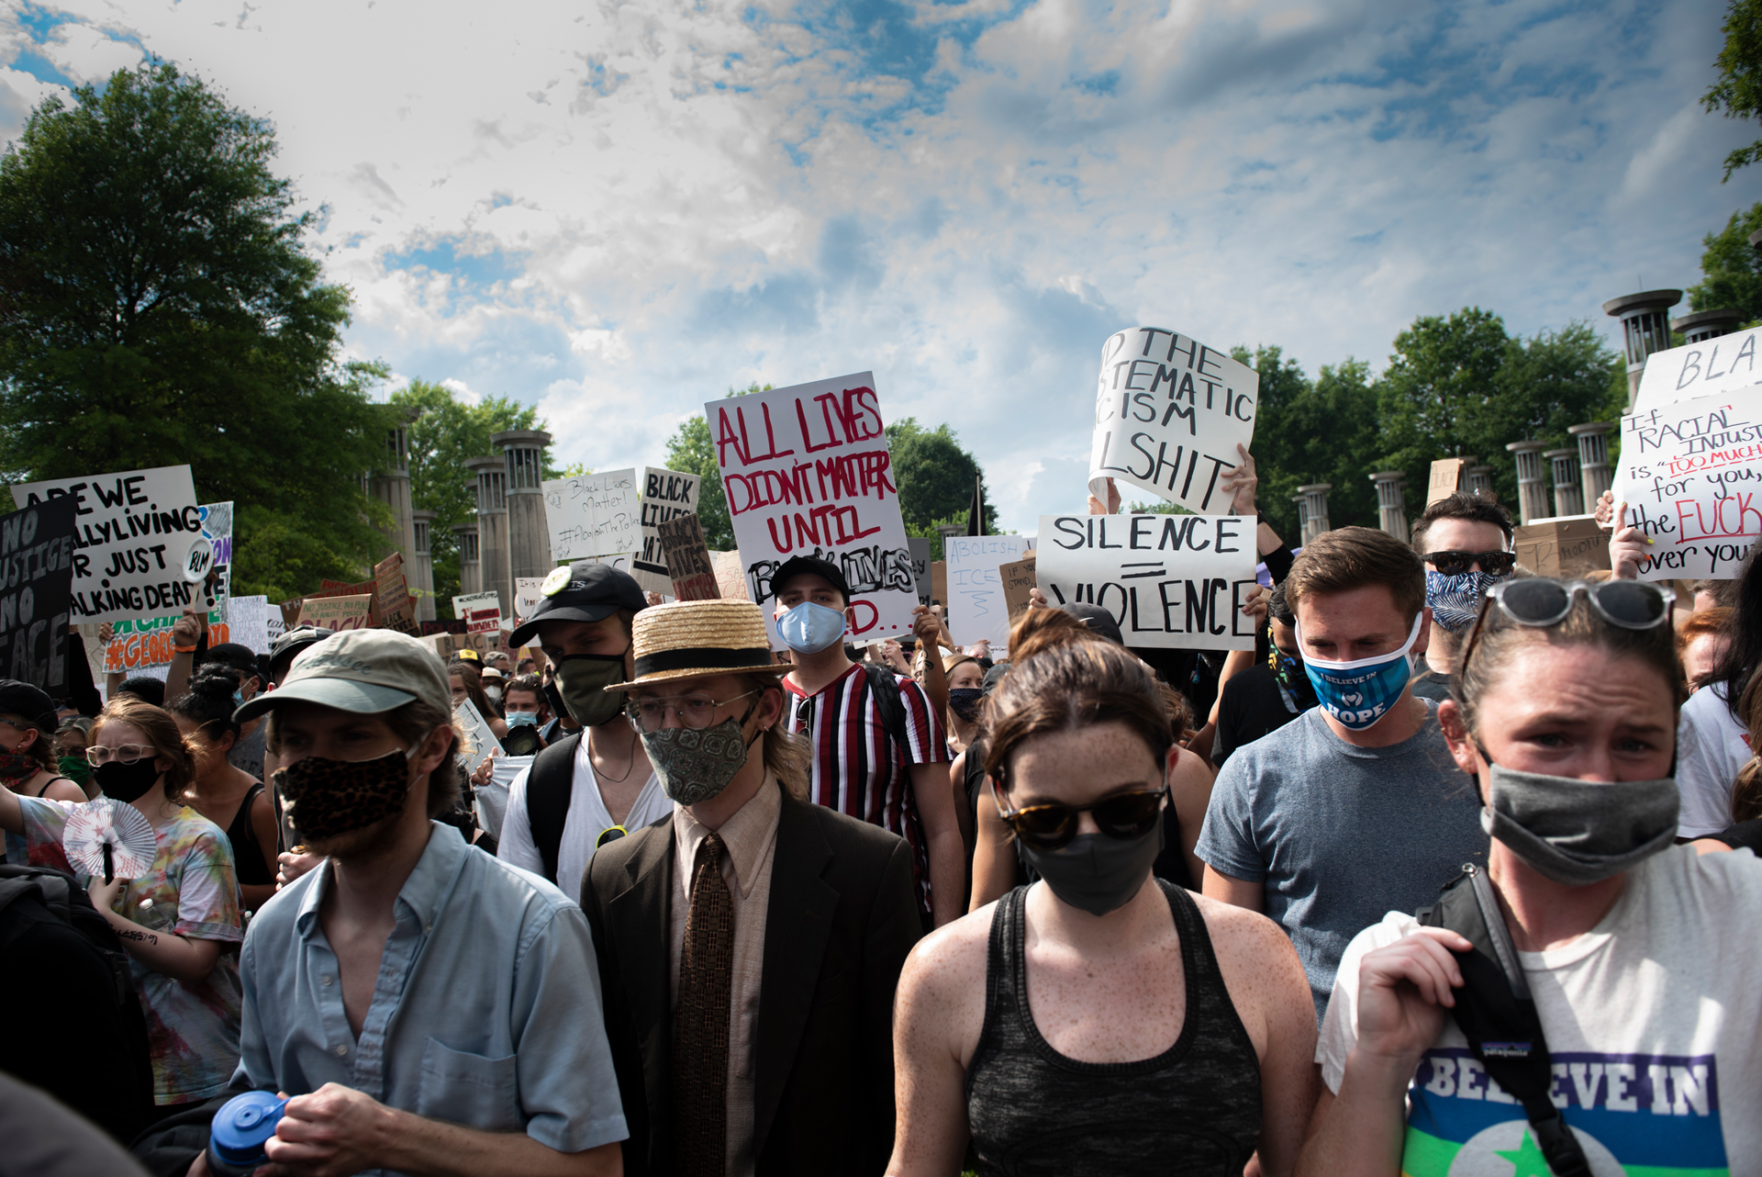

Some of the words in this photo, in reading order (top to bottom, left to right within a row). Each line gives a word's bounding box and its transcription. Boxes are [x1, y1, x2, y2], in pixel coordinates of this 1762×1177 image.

[1139, 327, 1226, 381] THE
[1676, 333, 1757, 391] BLA
[717, 400, 794, 467] ALL
[795, 385, 883, 453] LIVES
[1096, 392, 1196, 437] CISM
[1623, 409, 1663, 433] If
[1639, 409, 1750, 453] RACIAL
[1679, 424, 1762, 456] INJUST
[815, 450, 897, 501] MATTER
[1099, 431, 1235, 511] LSHIT
[1630, 466, 1651, 480] is
[92, 475, 149, 509] WE
[565, 478, 600, 500] Black
[604, 477, 633, 493] Lives
[582, 490, 628, 513] Matter!
[646, 473, 693, 504] BLACK
[1650, 475, 1695, 502] for
[2, 509, 39, 556] NO
[767, 504, 881, 554] UNTIL
[1627, 503, 1675, 536] the
[1675, 492, 1762, 540] FUCK
[950, 540, 1018, 564] ABOLISH
[1053, 516, 1242, 554] SILENCE
[73, 553, 92, 578] R
[104, 544, 167, 577] JUST
[189, 550, 210, 573] BLM
[842, 544, 916, 595] LIVES
[1636, 545, 1697, 574] over
[1704, 544, 1749, 573] you
[953, 568, 1000, 586] ICE
[0, 585, 35, 634] NO
[1050, 578, 1258, 637] VIOLENCE
[443, 634, 485, 652] BLAC
[1326, 675, 1365, 685] BELIEVE
[1366, 671, 1377, 680] IN
[1327, 702, 1386, 723] HOPE
[1425, 1056, 1639, 1112] BELEVE
[1648, 1063, 1710, 1116] IN
